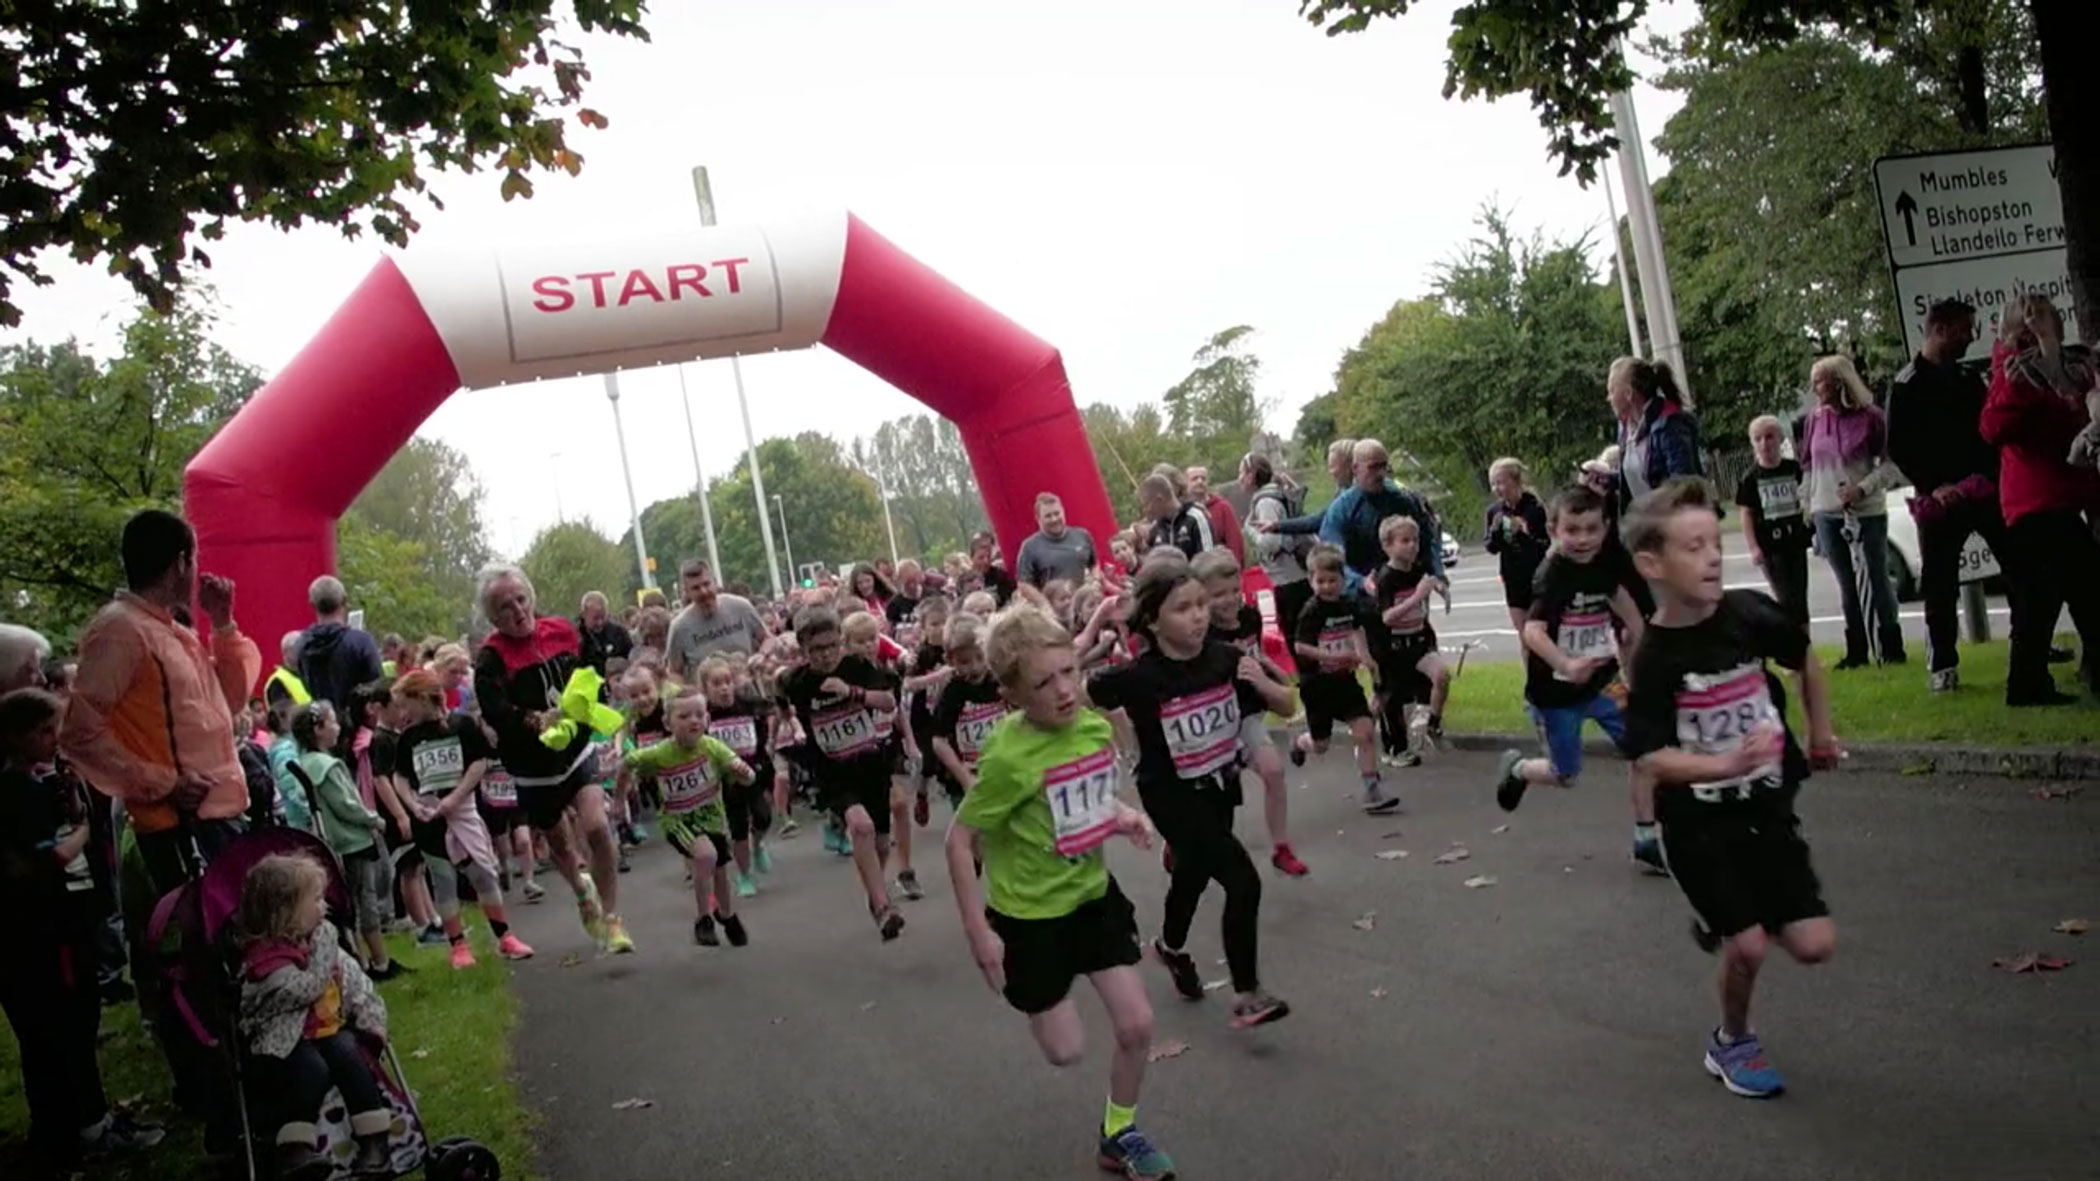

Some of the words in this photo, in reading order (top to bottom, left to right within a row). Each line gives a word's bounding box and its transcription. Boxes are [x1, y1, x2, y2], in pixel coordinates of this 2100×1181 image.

[1920, 166, 2008, 193] Mumbles
[1926, 202, 2032, 228] Bishopston
[1931, 227, 2017, 256] Llandeilo
[531, 258, 749, 313] START
[819, 715, 867, 743] 1161
[1171, 700, 1236, 743] 1020
[1688, 702, 1764, 744] 128
[417, 747, 459, 774] 1356
[664, 771, 708, 795] 1261
